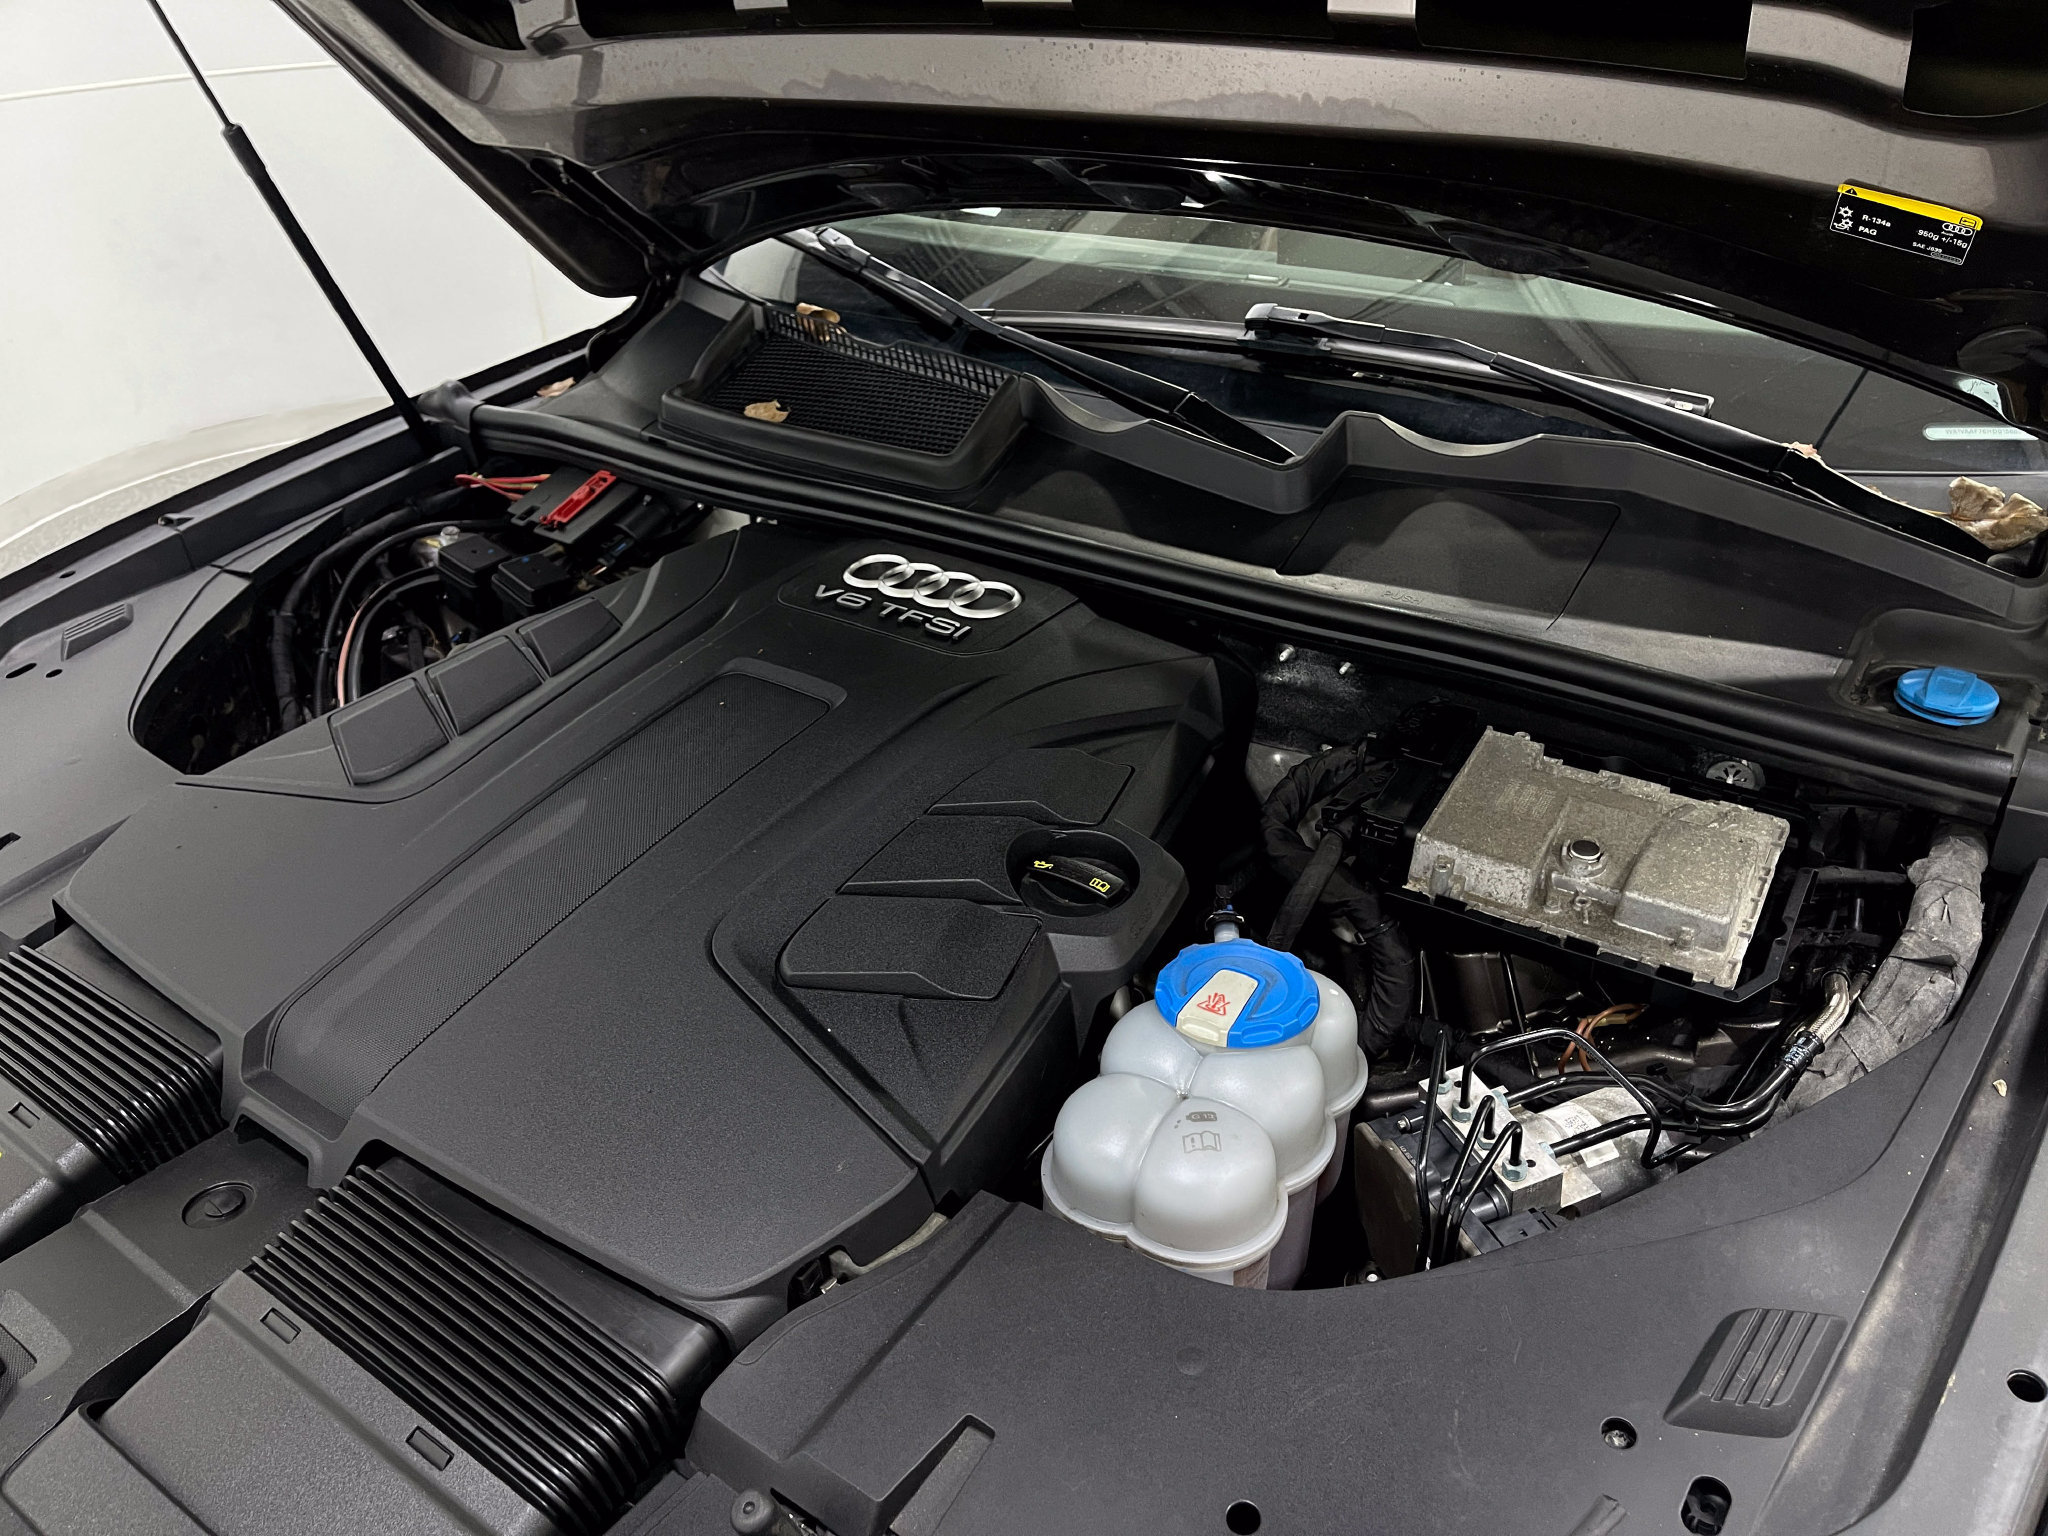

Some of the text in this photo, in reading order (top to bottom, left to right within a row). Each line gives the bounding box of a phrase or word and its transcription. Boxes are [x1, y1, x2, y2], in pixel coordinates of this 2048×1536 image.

[1862, 214, 1891, 227] R-134a
[1858, 225, 1878, 236] PAG
[1917, 229, 1940, 241] 950g
[1912, 241, 1926, 250] SAE
[815, 584, 973, 640] V6 TFSI
